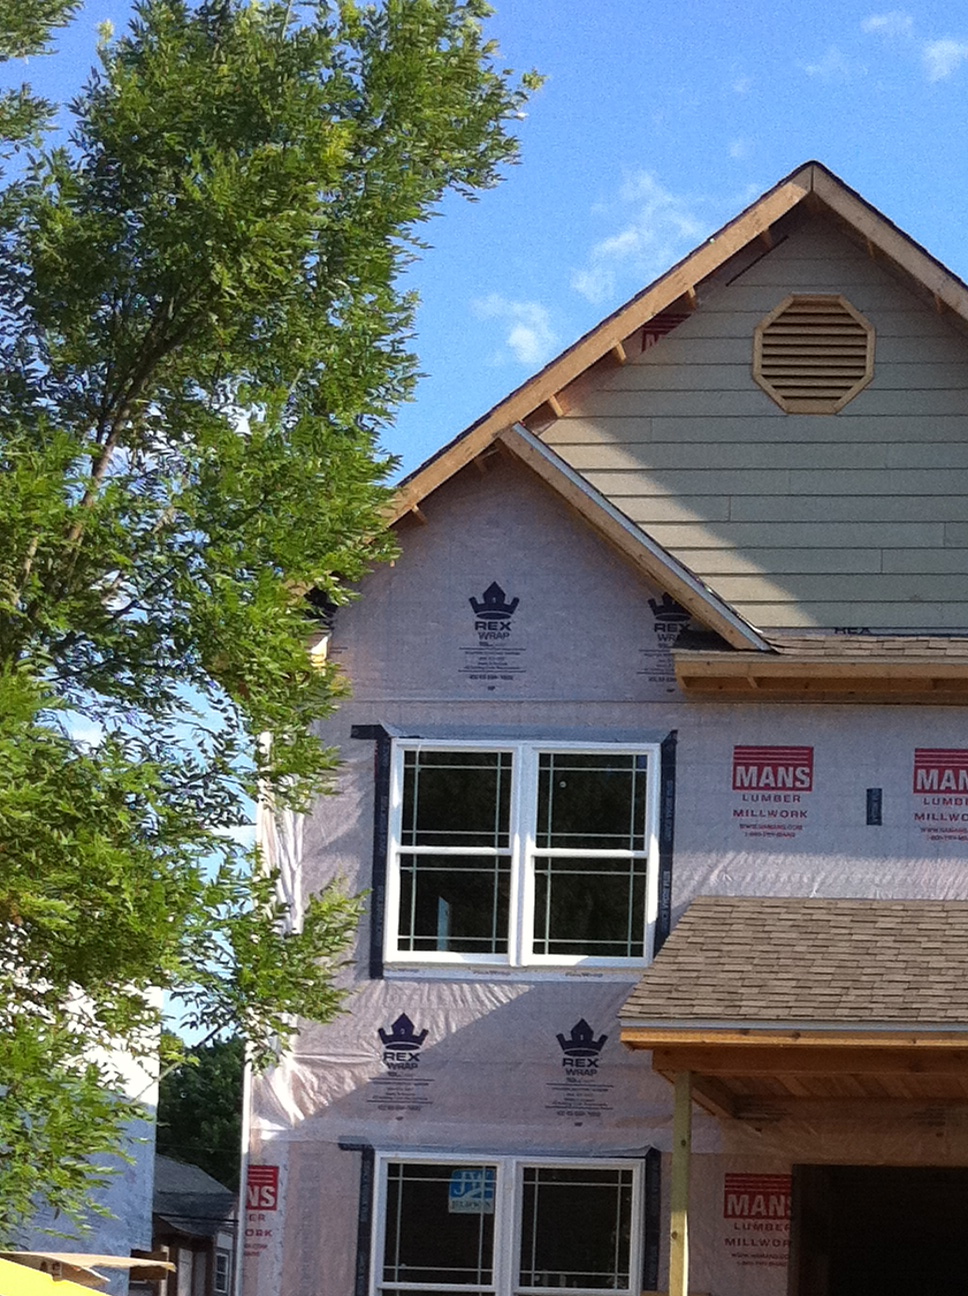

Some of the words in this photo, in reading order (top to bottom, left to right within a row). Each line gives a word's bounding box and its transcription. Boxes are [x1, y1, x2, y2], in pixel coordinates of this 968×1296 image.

[475, 621, 512, 631] REX
[478, 632, 510, 640] WRAP
[735, 766, 811, 789] MANS
[742, 794, 801, 803] LUMBER
[733, 809, 808, 818] MILLWORK
[383, 1052, 420, 1062] REX
[386, 1062, 418, 1070] WRAP
[562, 1058, 599, 1068] REX
[565, 1068, 598, 1076] WRAP
[727, 1194, 792, 1216] MAN
